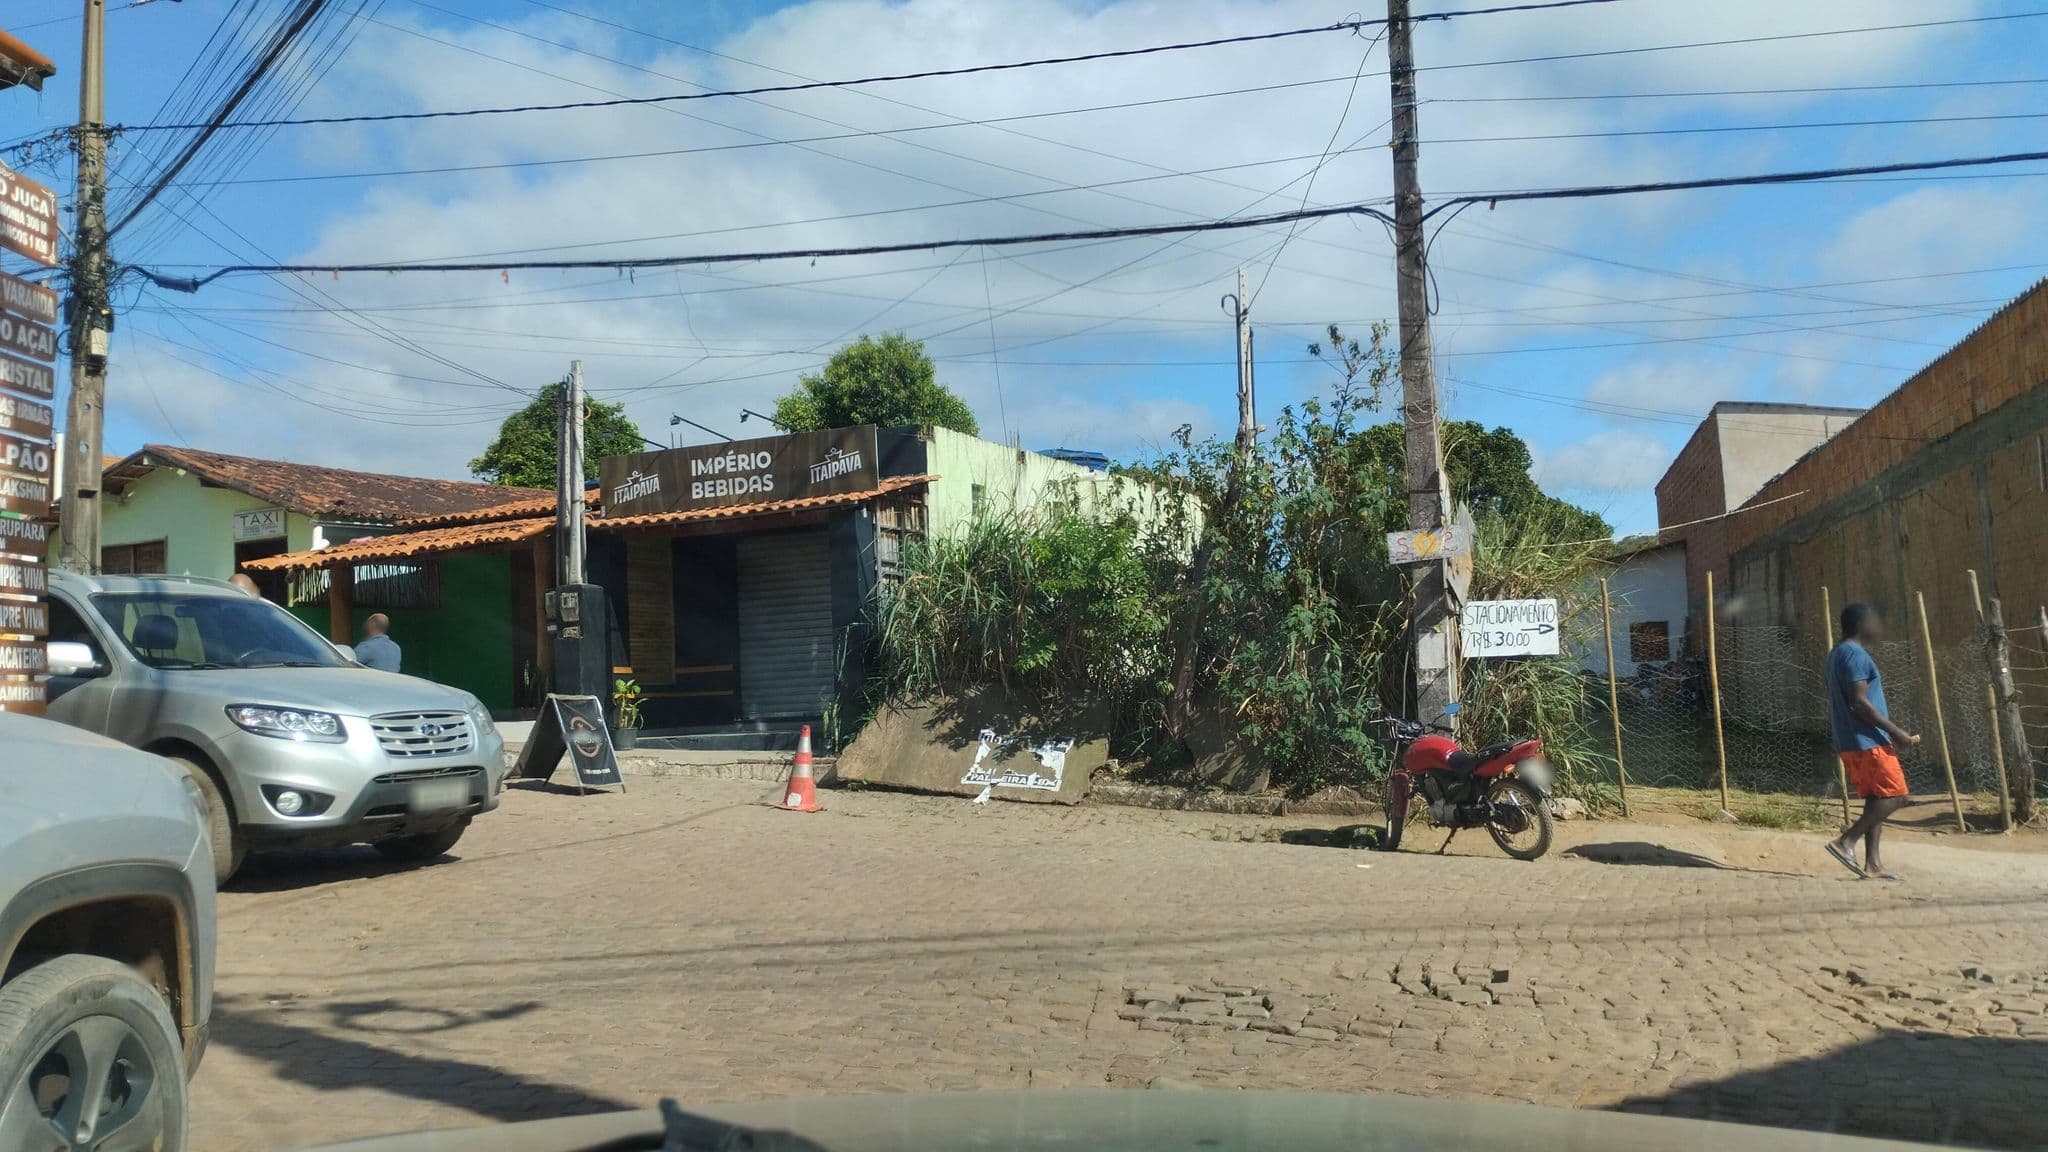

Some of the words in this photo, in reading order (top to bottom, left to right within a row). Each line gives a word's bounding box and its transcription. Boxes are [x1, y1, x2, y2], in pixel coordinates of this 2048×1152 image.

[11, 186, 50, 217] JUCA
[3, 278, 55, 318] VARANDA
[691, 450, 772, 477] IMPÉRIO
[811, 453, 862, 484] ITAIPAVA
[614, 477, 661, 505] ITAIPAVA
[692, 473, 775, 500] BEBIDAS
[240, 511, 279, 527] TAXI
[23, 567, 45, 591] VIVA
[22, 607, 45, 630] VIVA
[1470, 631, 1493, 649] R$
[1495, 631, 1531, 648] 30,00
